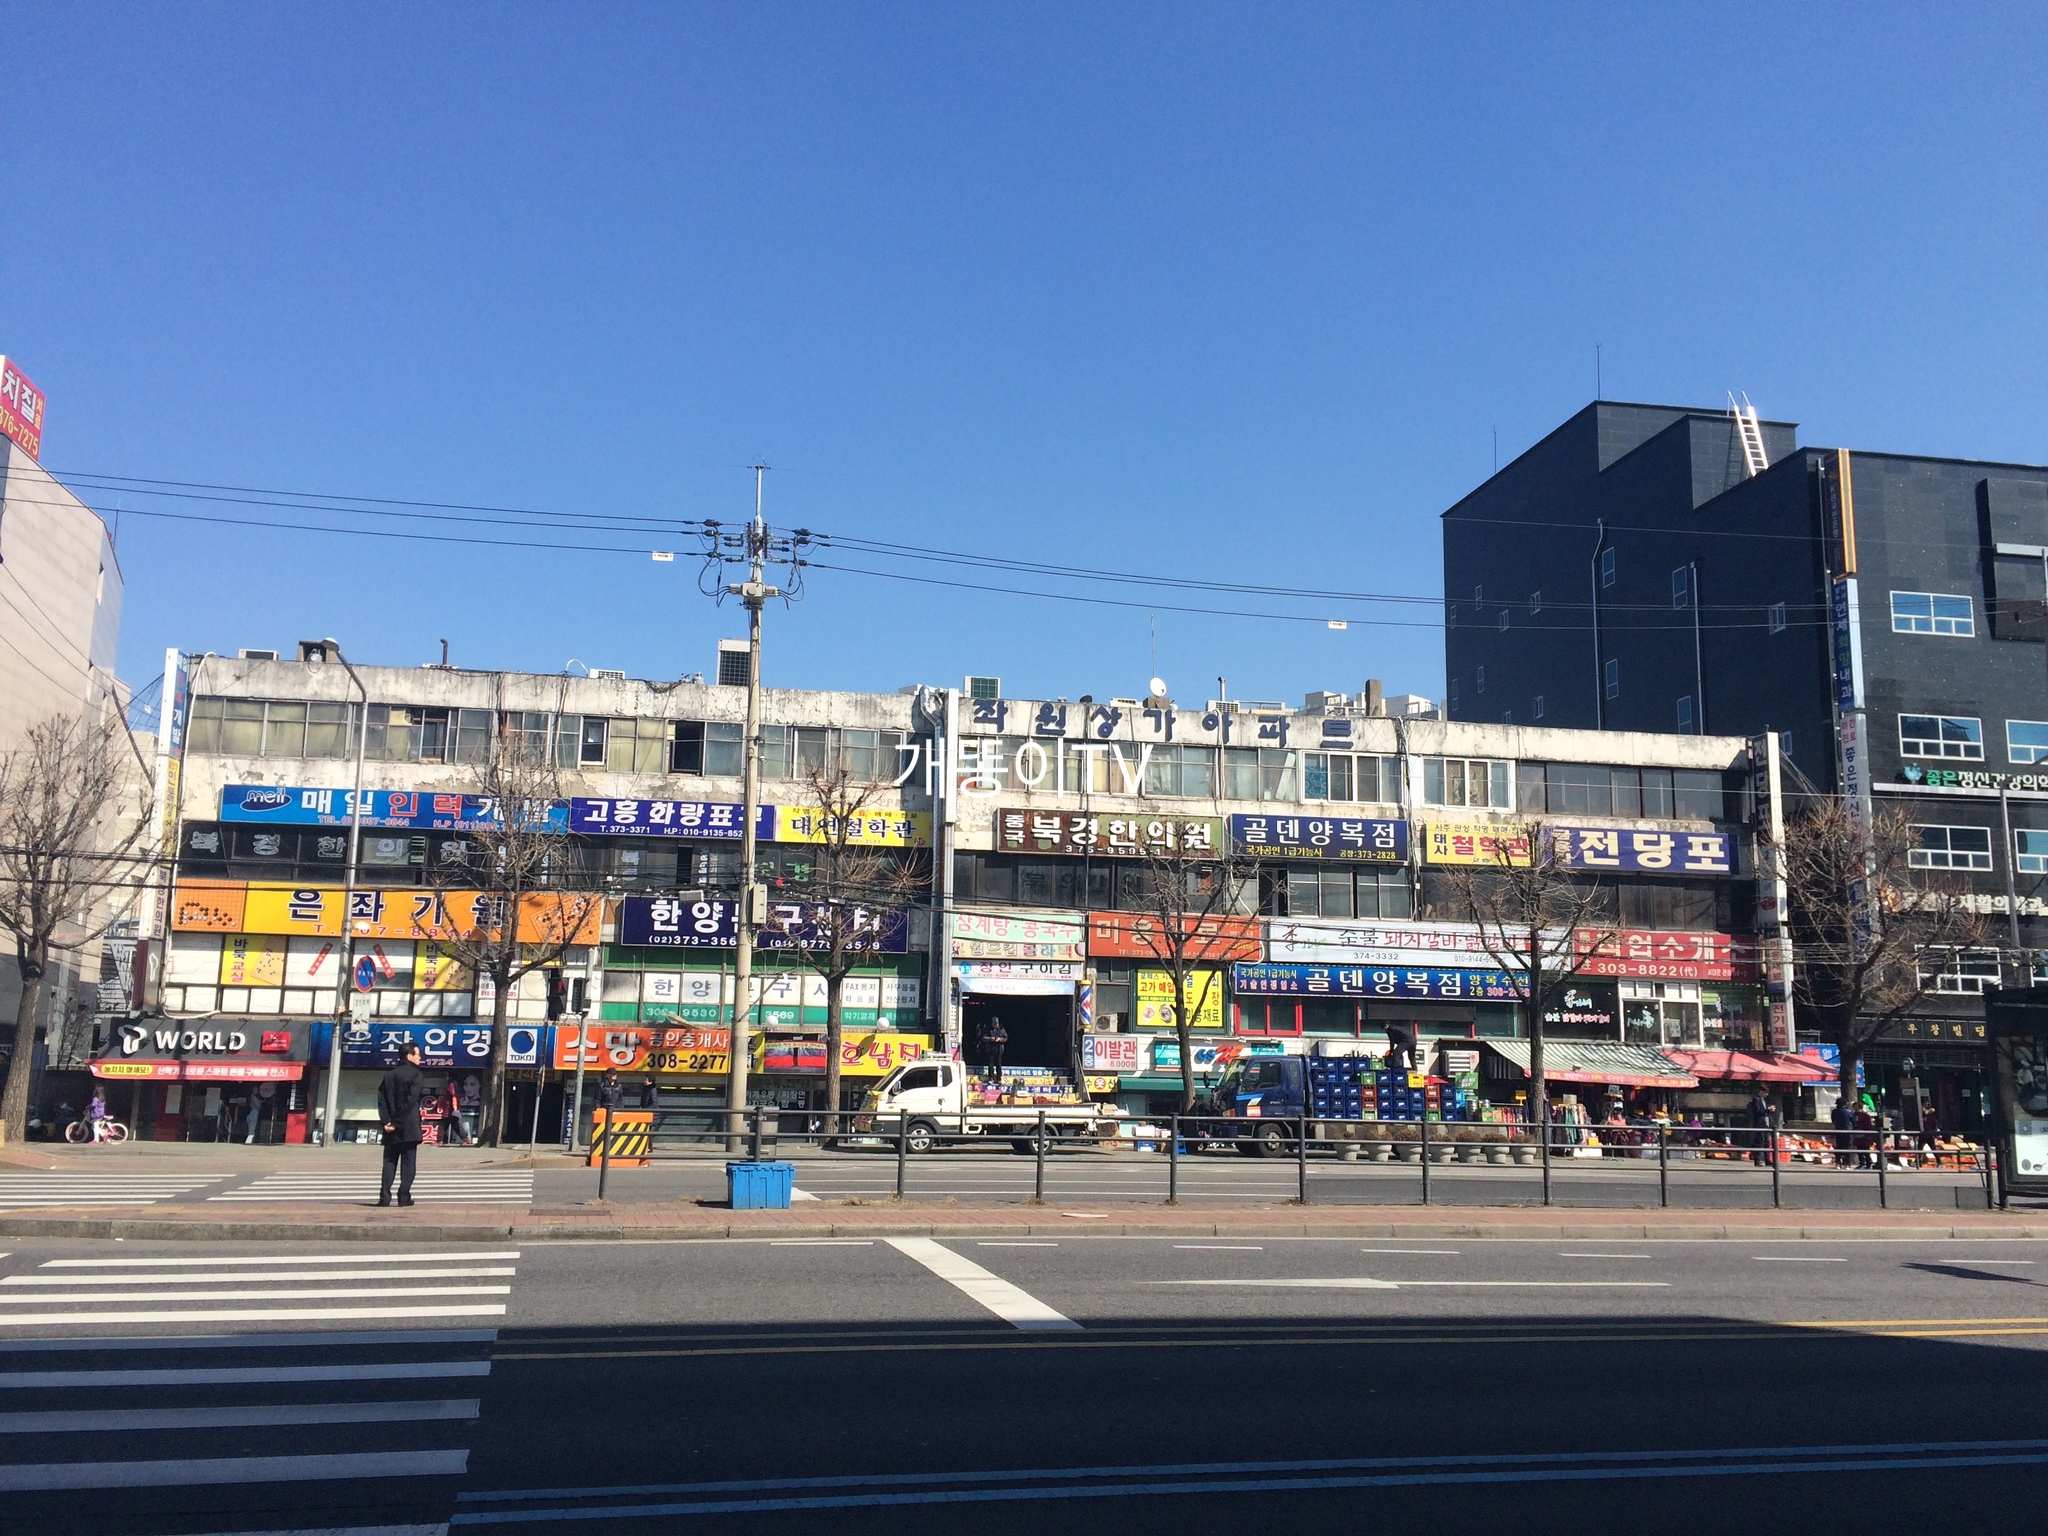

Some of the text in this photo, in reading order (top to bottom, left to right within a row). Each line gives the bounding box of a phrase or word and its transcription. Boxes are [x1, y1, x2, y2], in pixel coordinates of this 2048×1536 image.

[973, 698, 1354, 749] 좌원상가아파트
[246, 788, 287, 804] meil
[1032, 815, 1211, 849] 북경한의원
[1243, 818, 1395, 849] 골덴양복점
[1579, 830, 1730, 872] 전당포
[648, 935, 738, 946] (02)373-356
[1353, 952, 1399, 961] 374-3332
[1305, 967, 1461, 997] 골덴양복점
[155, 1030, 246, 1051] WORLD
[649, 1031, 729, 1049] 공인중개사
[1095, 1039, 1137, 1060] 이발관
[647, 1053, 728, 1070] 308-2277
